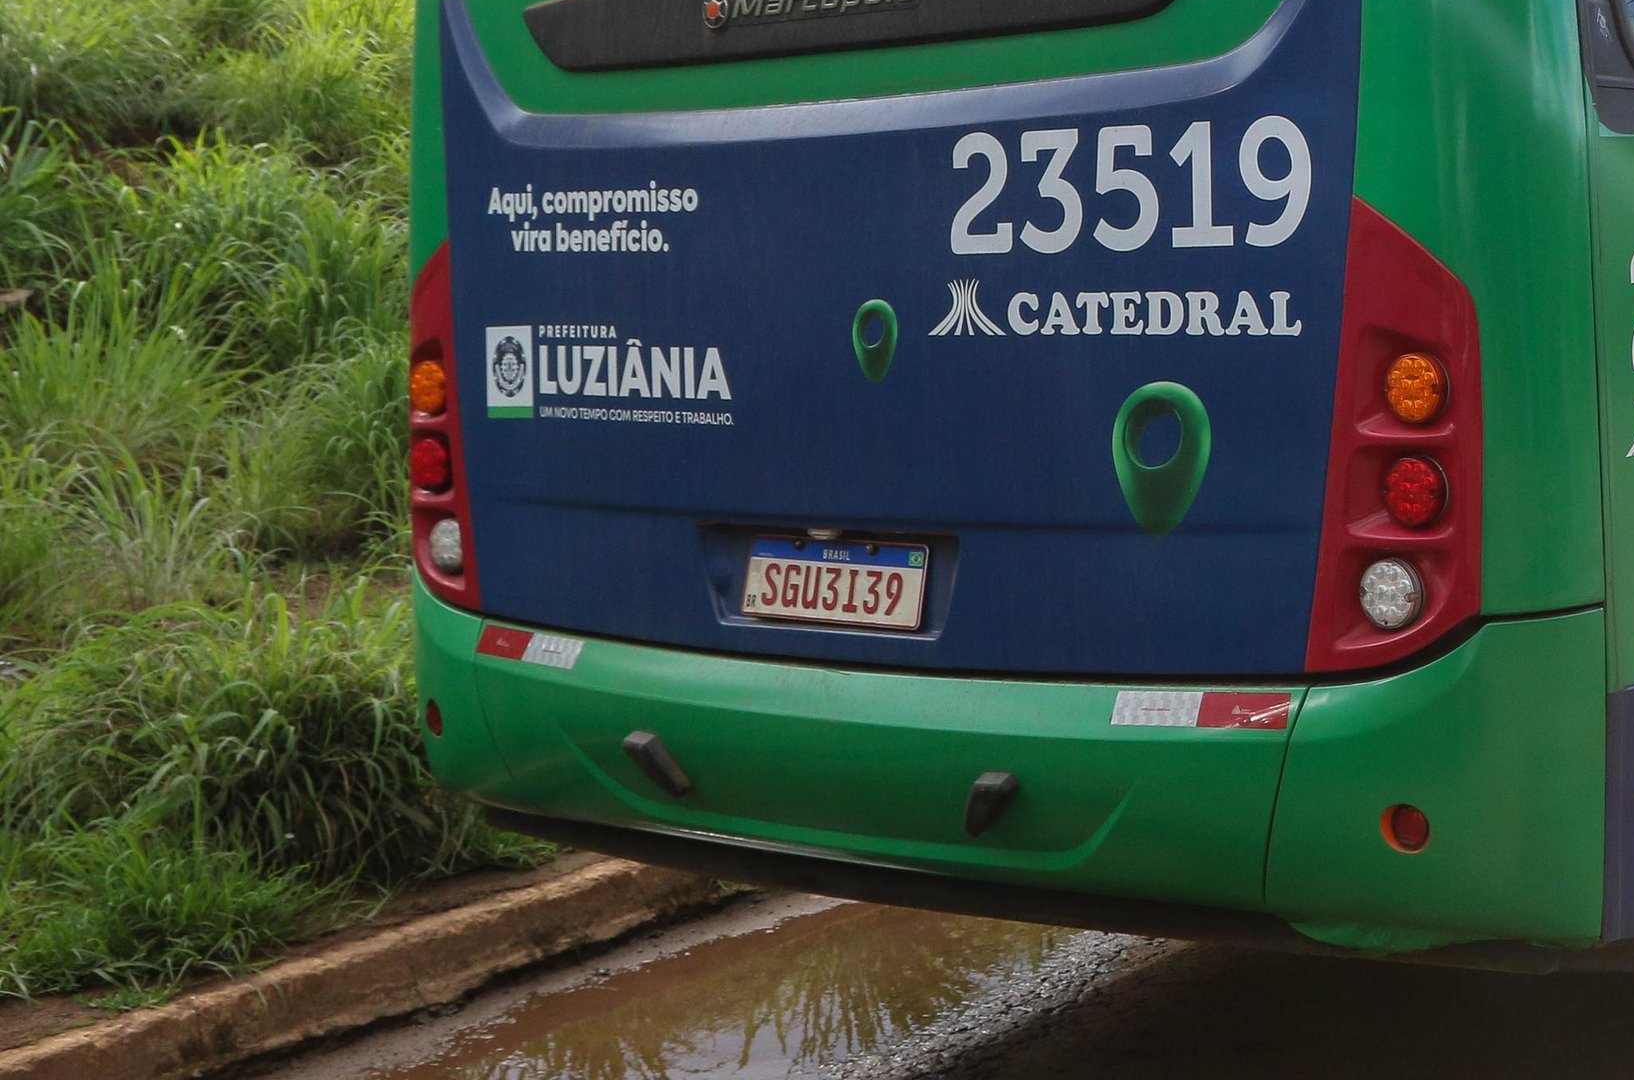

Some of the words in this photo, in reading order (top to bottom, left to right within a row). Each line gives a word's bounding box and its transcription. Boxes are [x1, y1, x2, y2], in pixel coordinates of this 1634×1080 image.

[487, 183, 538, 222] Aqui,
[541, 180, 699, 221] compromisso
[949, 115, 1313, 256] 23519
[511, 221, 551, 252] vira
[556, 219, 669, 252] benefício.
[538, 325, 617, 338] PREFEITURA
[1006, 290, 1302, 337] CATEDRAL
[539, 338, 732, 400] LUZIÂNIA
[539, 405, 553, 418] UM
[554, 406, 578, 419] NOVO
[579, 407, 608, 421] TEMPO
[609, 408, 631, 421] COM
[632, 410, 673, 423] RESPEITO
[675, 411, 681, 424] E
[682, 411, 734, 426] TRABALHO.
[822, 548, 851, 561] BRASIL
[761, 563, 903, 616] SGU3I39
